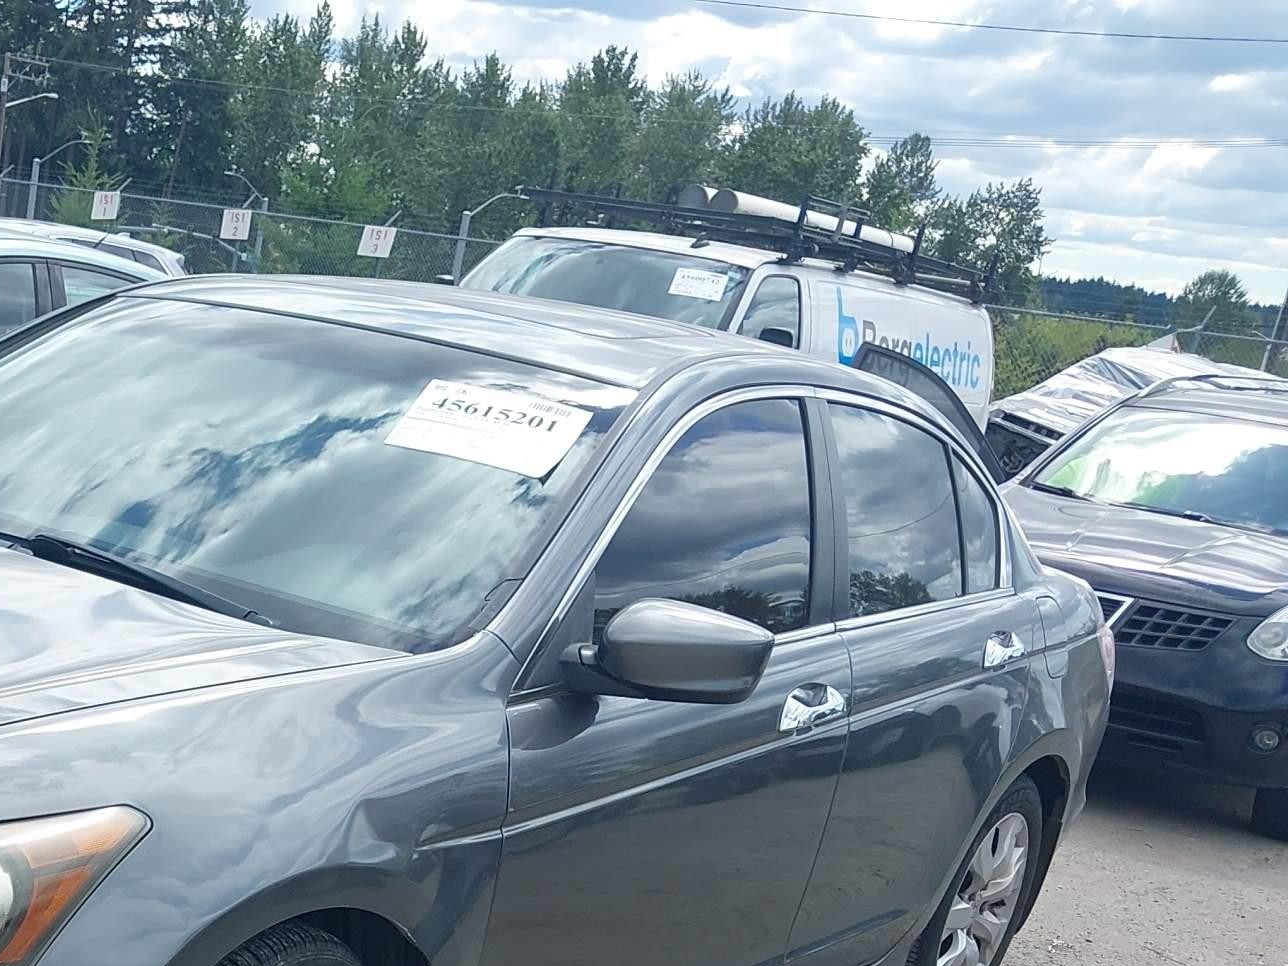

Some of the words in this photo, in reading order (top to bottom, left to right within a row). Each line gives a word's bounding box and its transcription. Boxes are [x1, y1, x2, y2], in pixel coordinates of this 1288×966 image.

[231, 226, 239, 237] 2
[371, 244, 379, 255] 3
[431, 397, 561, 433] 45615201
